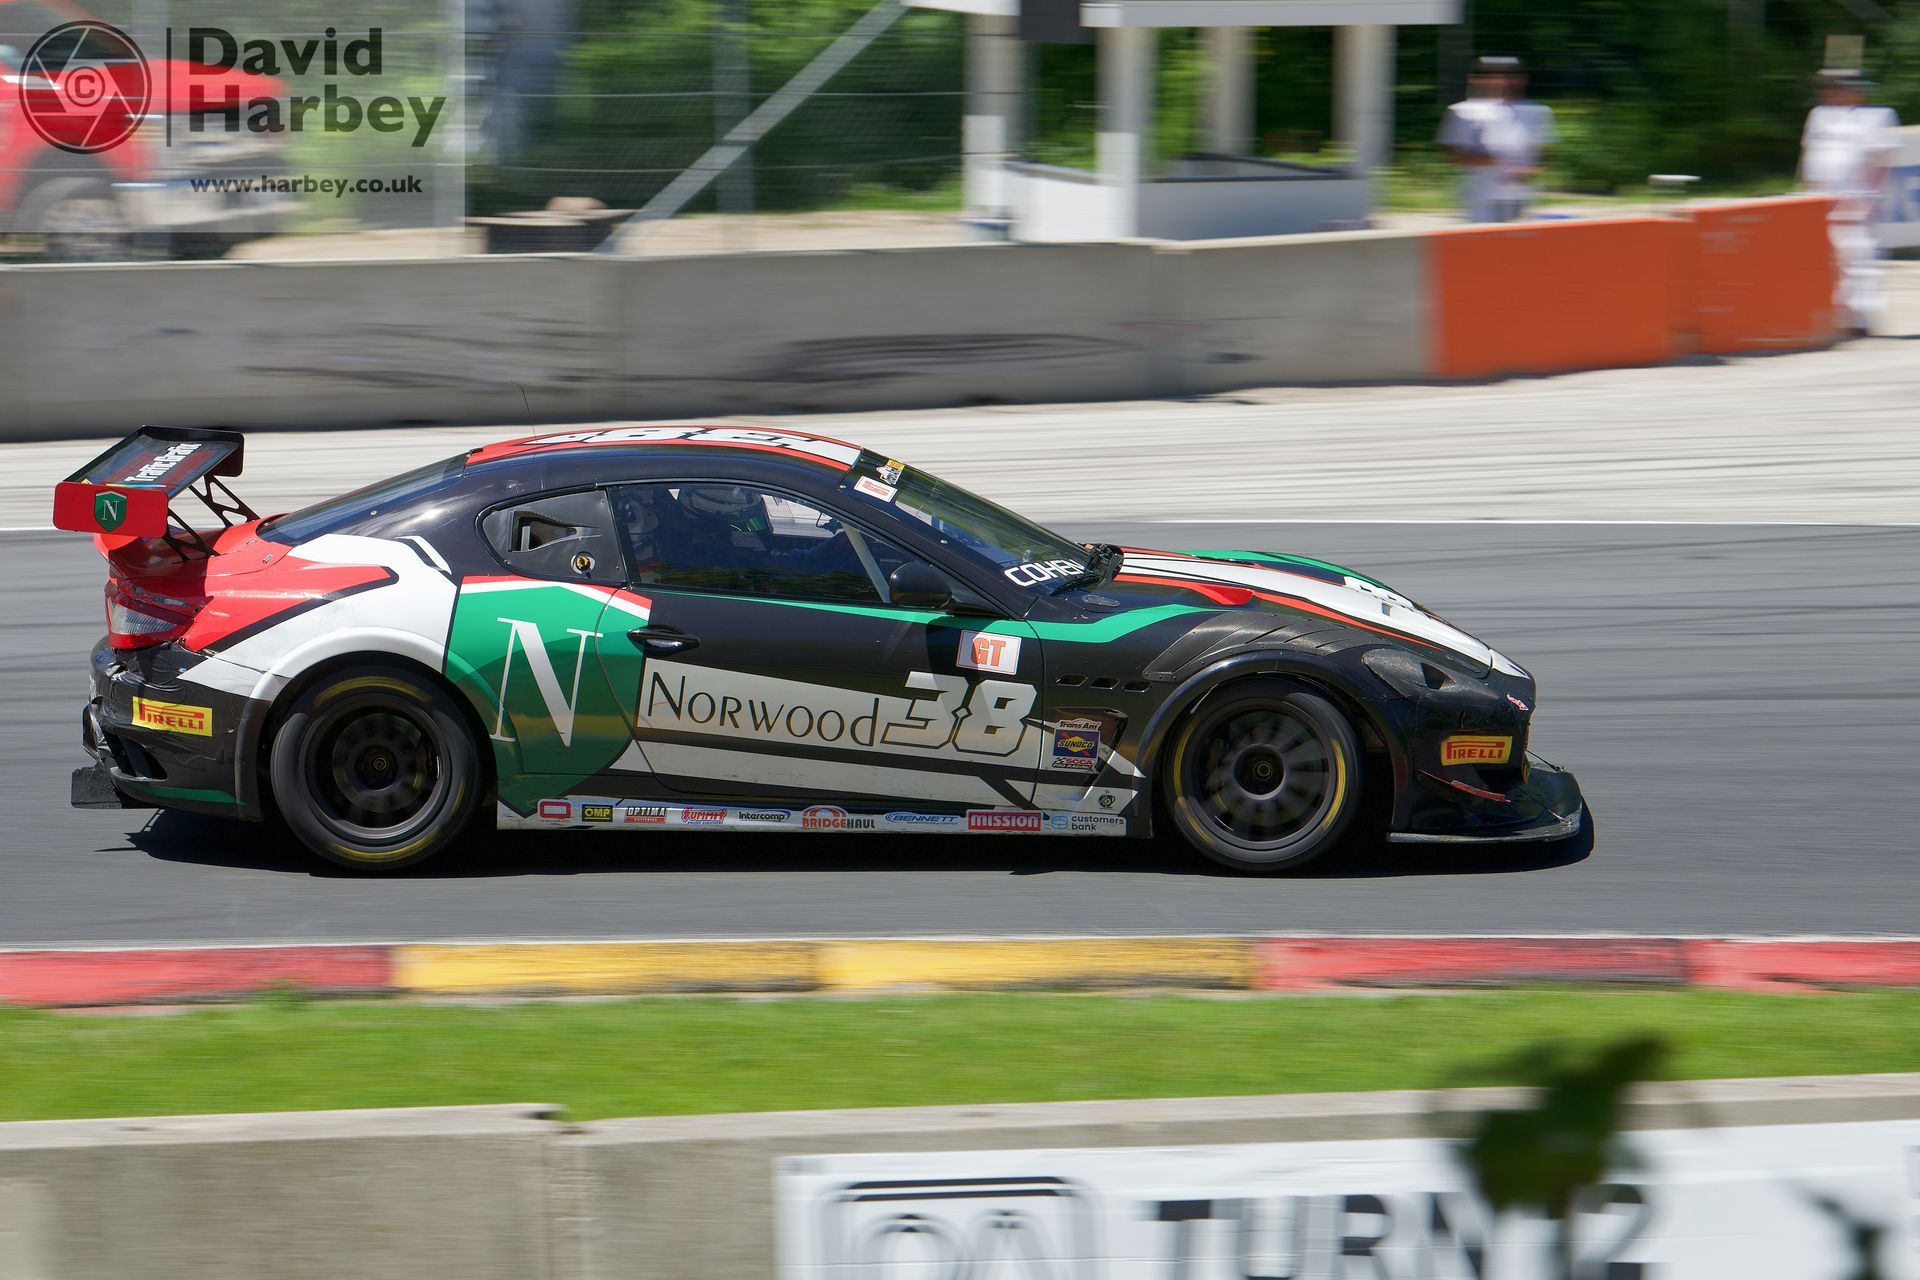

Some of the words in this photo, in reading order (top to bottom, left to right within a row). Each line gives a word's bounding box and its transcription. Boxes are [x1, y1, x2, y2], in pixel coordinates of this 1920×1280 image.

[100, 499, 121, 521] N
[1003, 559, 1087, 587] COHEN
[973, 637, 1006, 667] GT
[489, 617, 604, 748] N
[139, 702, 205, 730] PIRELLI
[880, 671, 1039, 757] 38
[1059, 720, 1083, 729] Trans
[1083, 722, 1098, 730] Am
[1058, 740, 1095, 749] SUNOCO
[1446, 741, 1506, 760] PIRELLI
[584, 807, 609, 817] OMP
[628, 807, 666, 816] OPTIMA
[739, 811, 786, 822] Intercomp
[802, 817, 876, 829] BRIDGEHAUL
[971, 815, 1039, 828] MISSION
[1071, 815, 1125, 825] customers
[1071, 822, 1097, 831] bank
[1135, 1190, 1490, 1280] TURN
